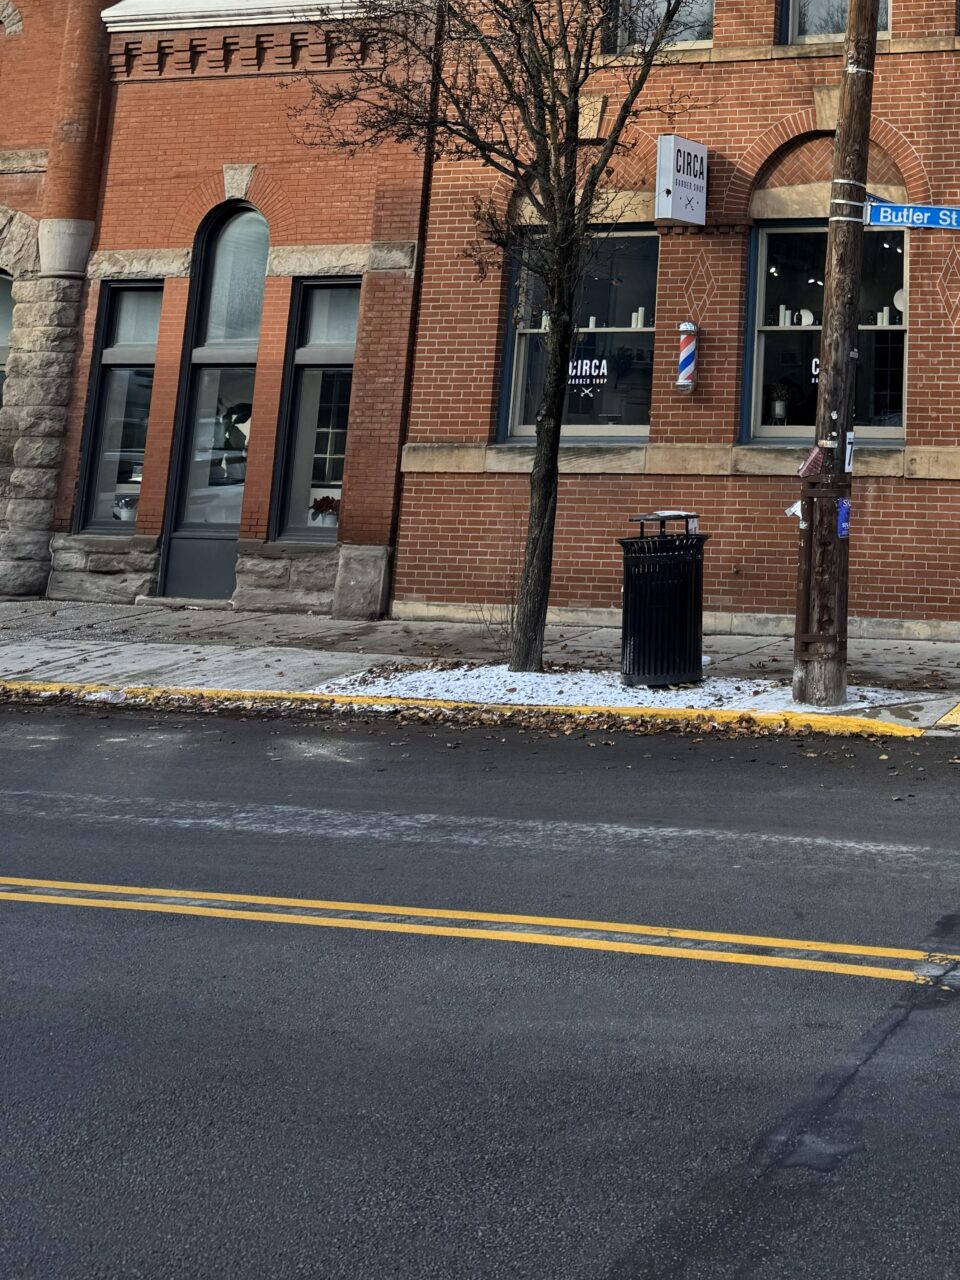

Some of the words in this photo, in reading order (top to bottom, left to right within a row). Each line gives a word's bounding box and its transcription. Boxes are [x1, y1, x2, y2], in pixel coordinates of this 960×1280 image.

[676, 149, 704, 180] CIRCA
[880, 207, 931, 224] Butler
[939, 210, 958, 226] St
[568, 359, 608, 376] CIRCA
